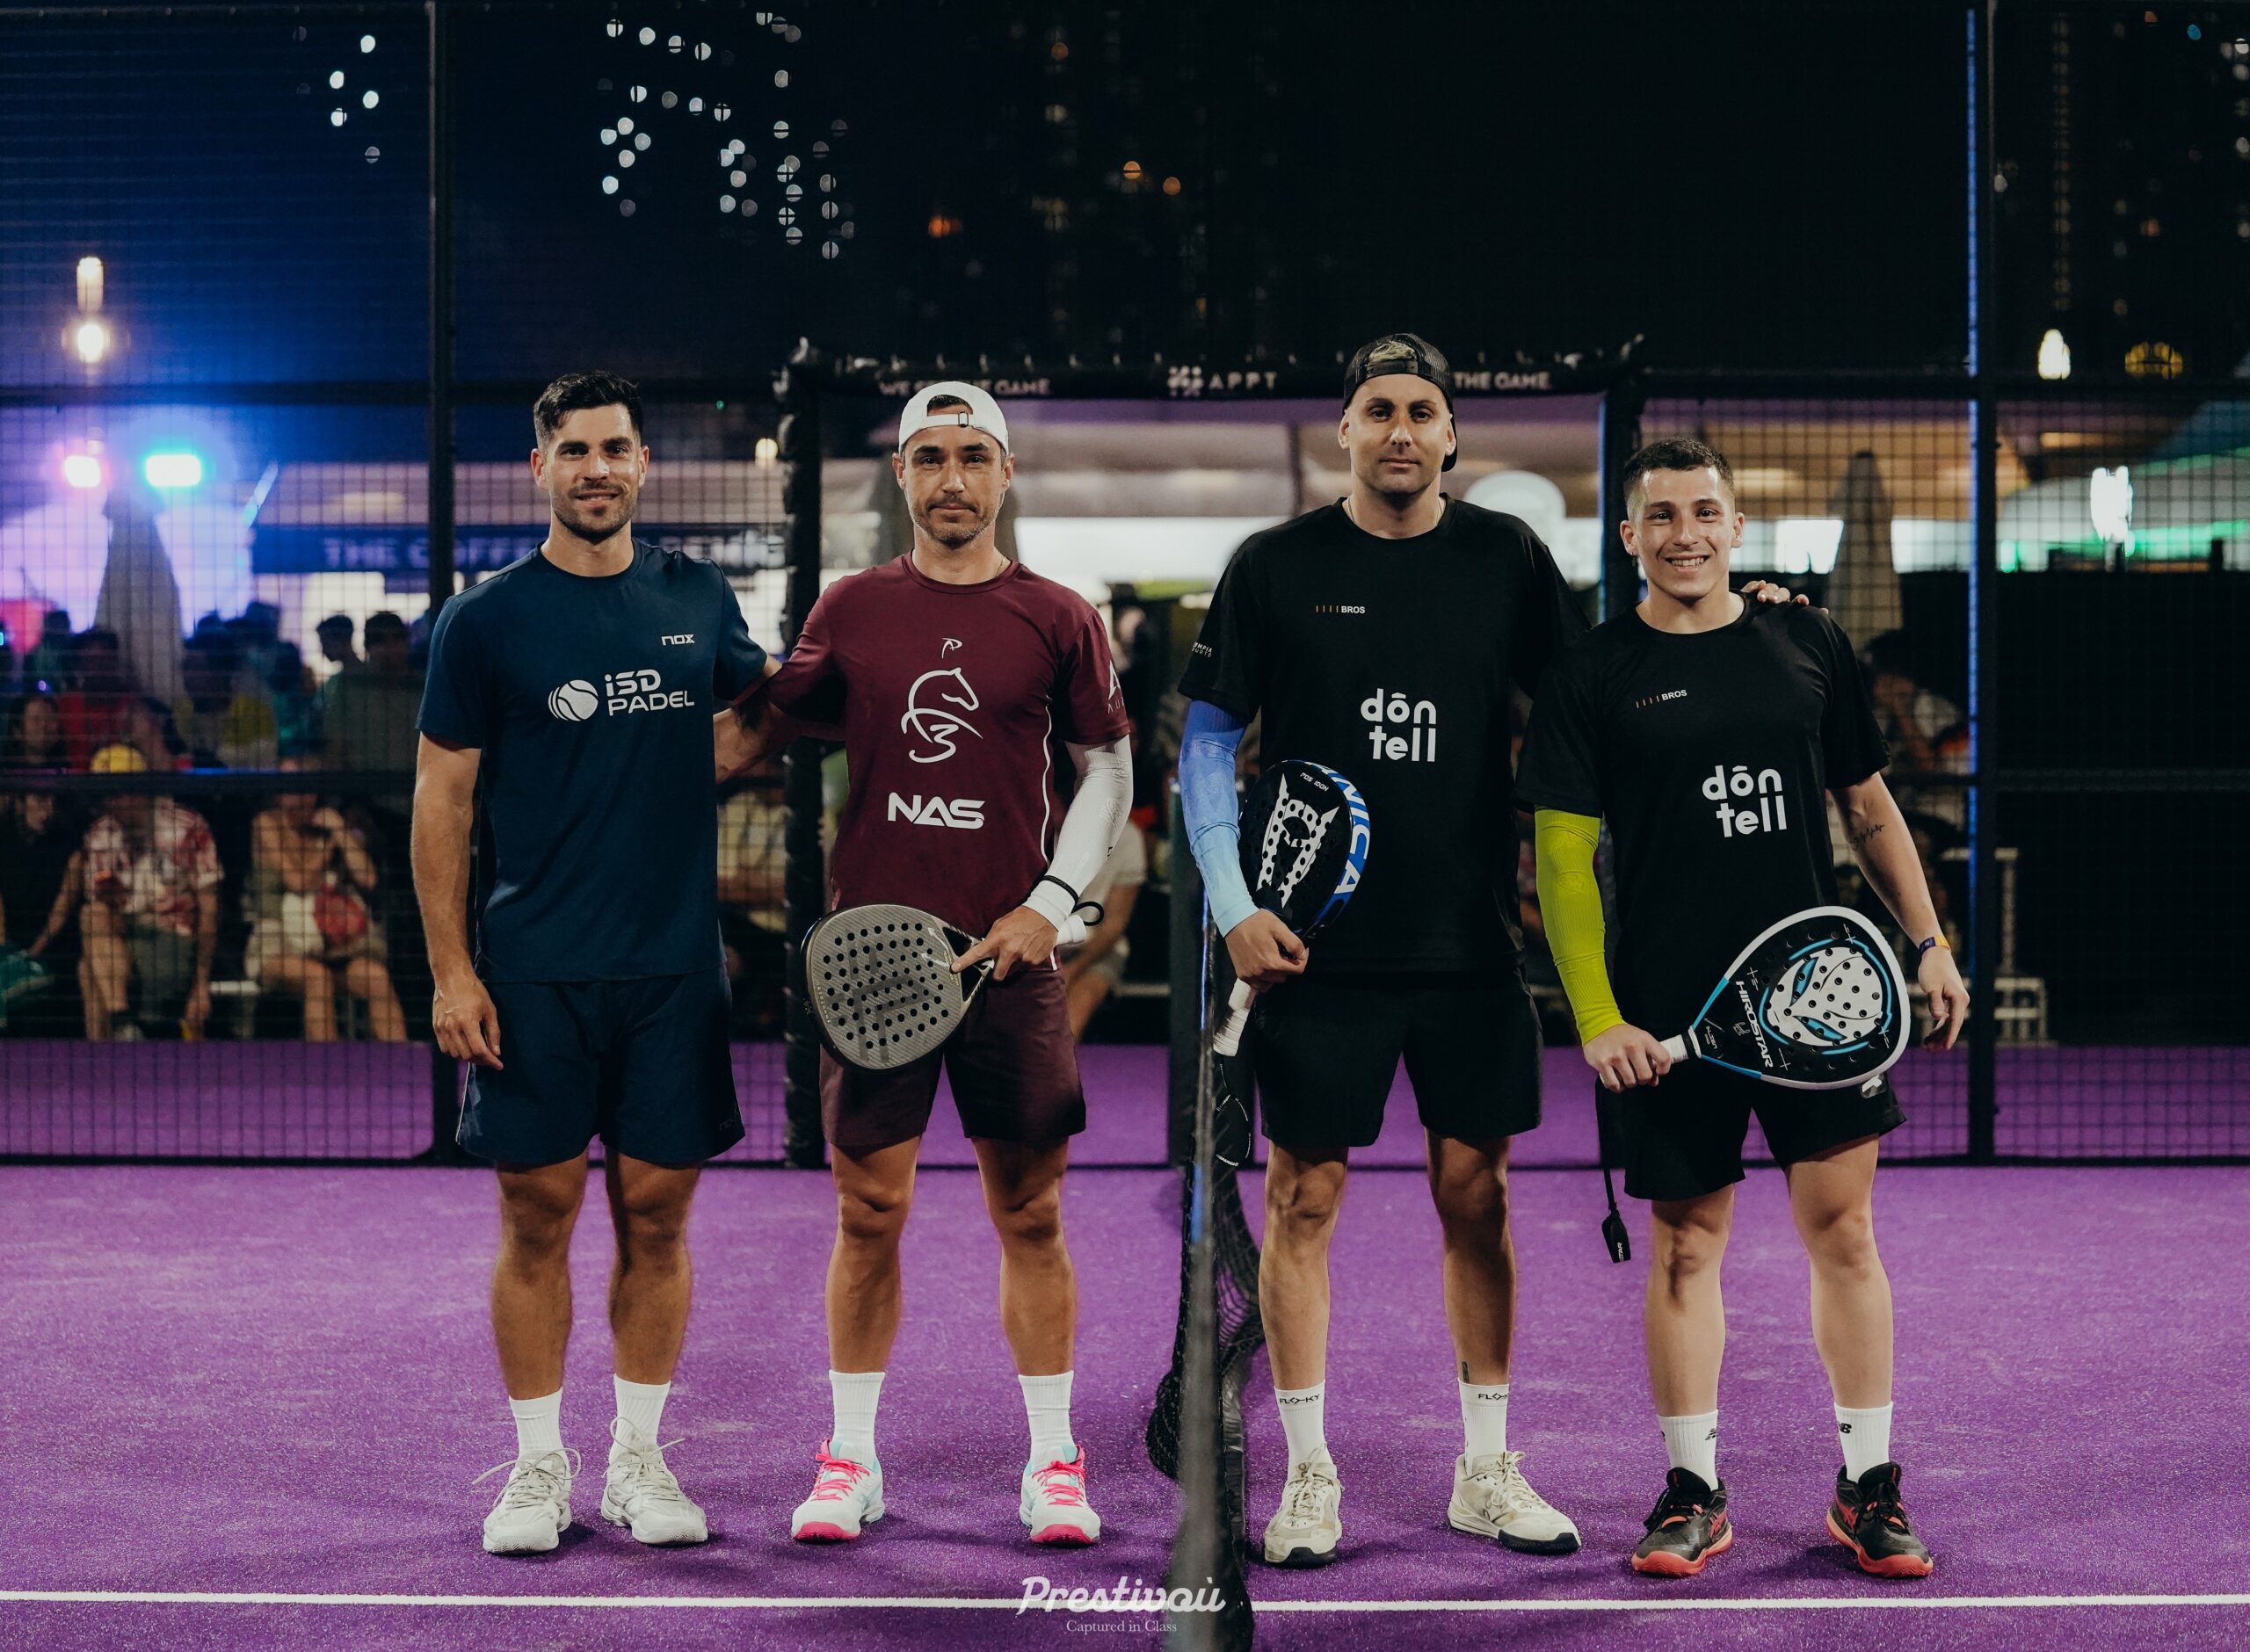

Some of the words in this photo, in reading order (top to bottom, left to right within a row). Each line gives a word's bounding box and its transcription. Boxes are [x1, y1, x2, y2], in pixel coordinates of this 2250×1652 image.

[994, 378, 1050, 395] GAME
[1208, 372, 1277, 389] APPT
[1453, 371, 1492, 389] THE
[1494, 371, 1552, 390] GAME
[608, 691, 694, 716] PADEL
[1368, 725, 1436, 763] tell
[887, 792, 985, 830] NAS
[1716, 795, 1788, 838] tell
[1735, 981, 1774, 1068] HIROSTAR
